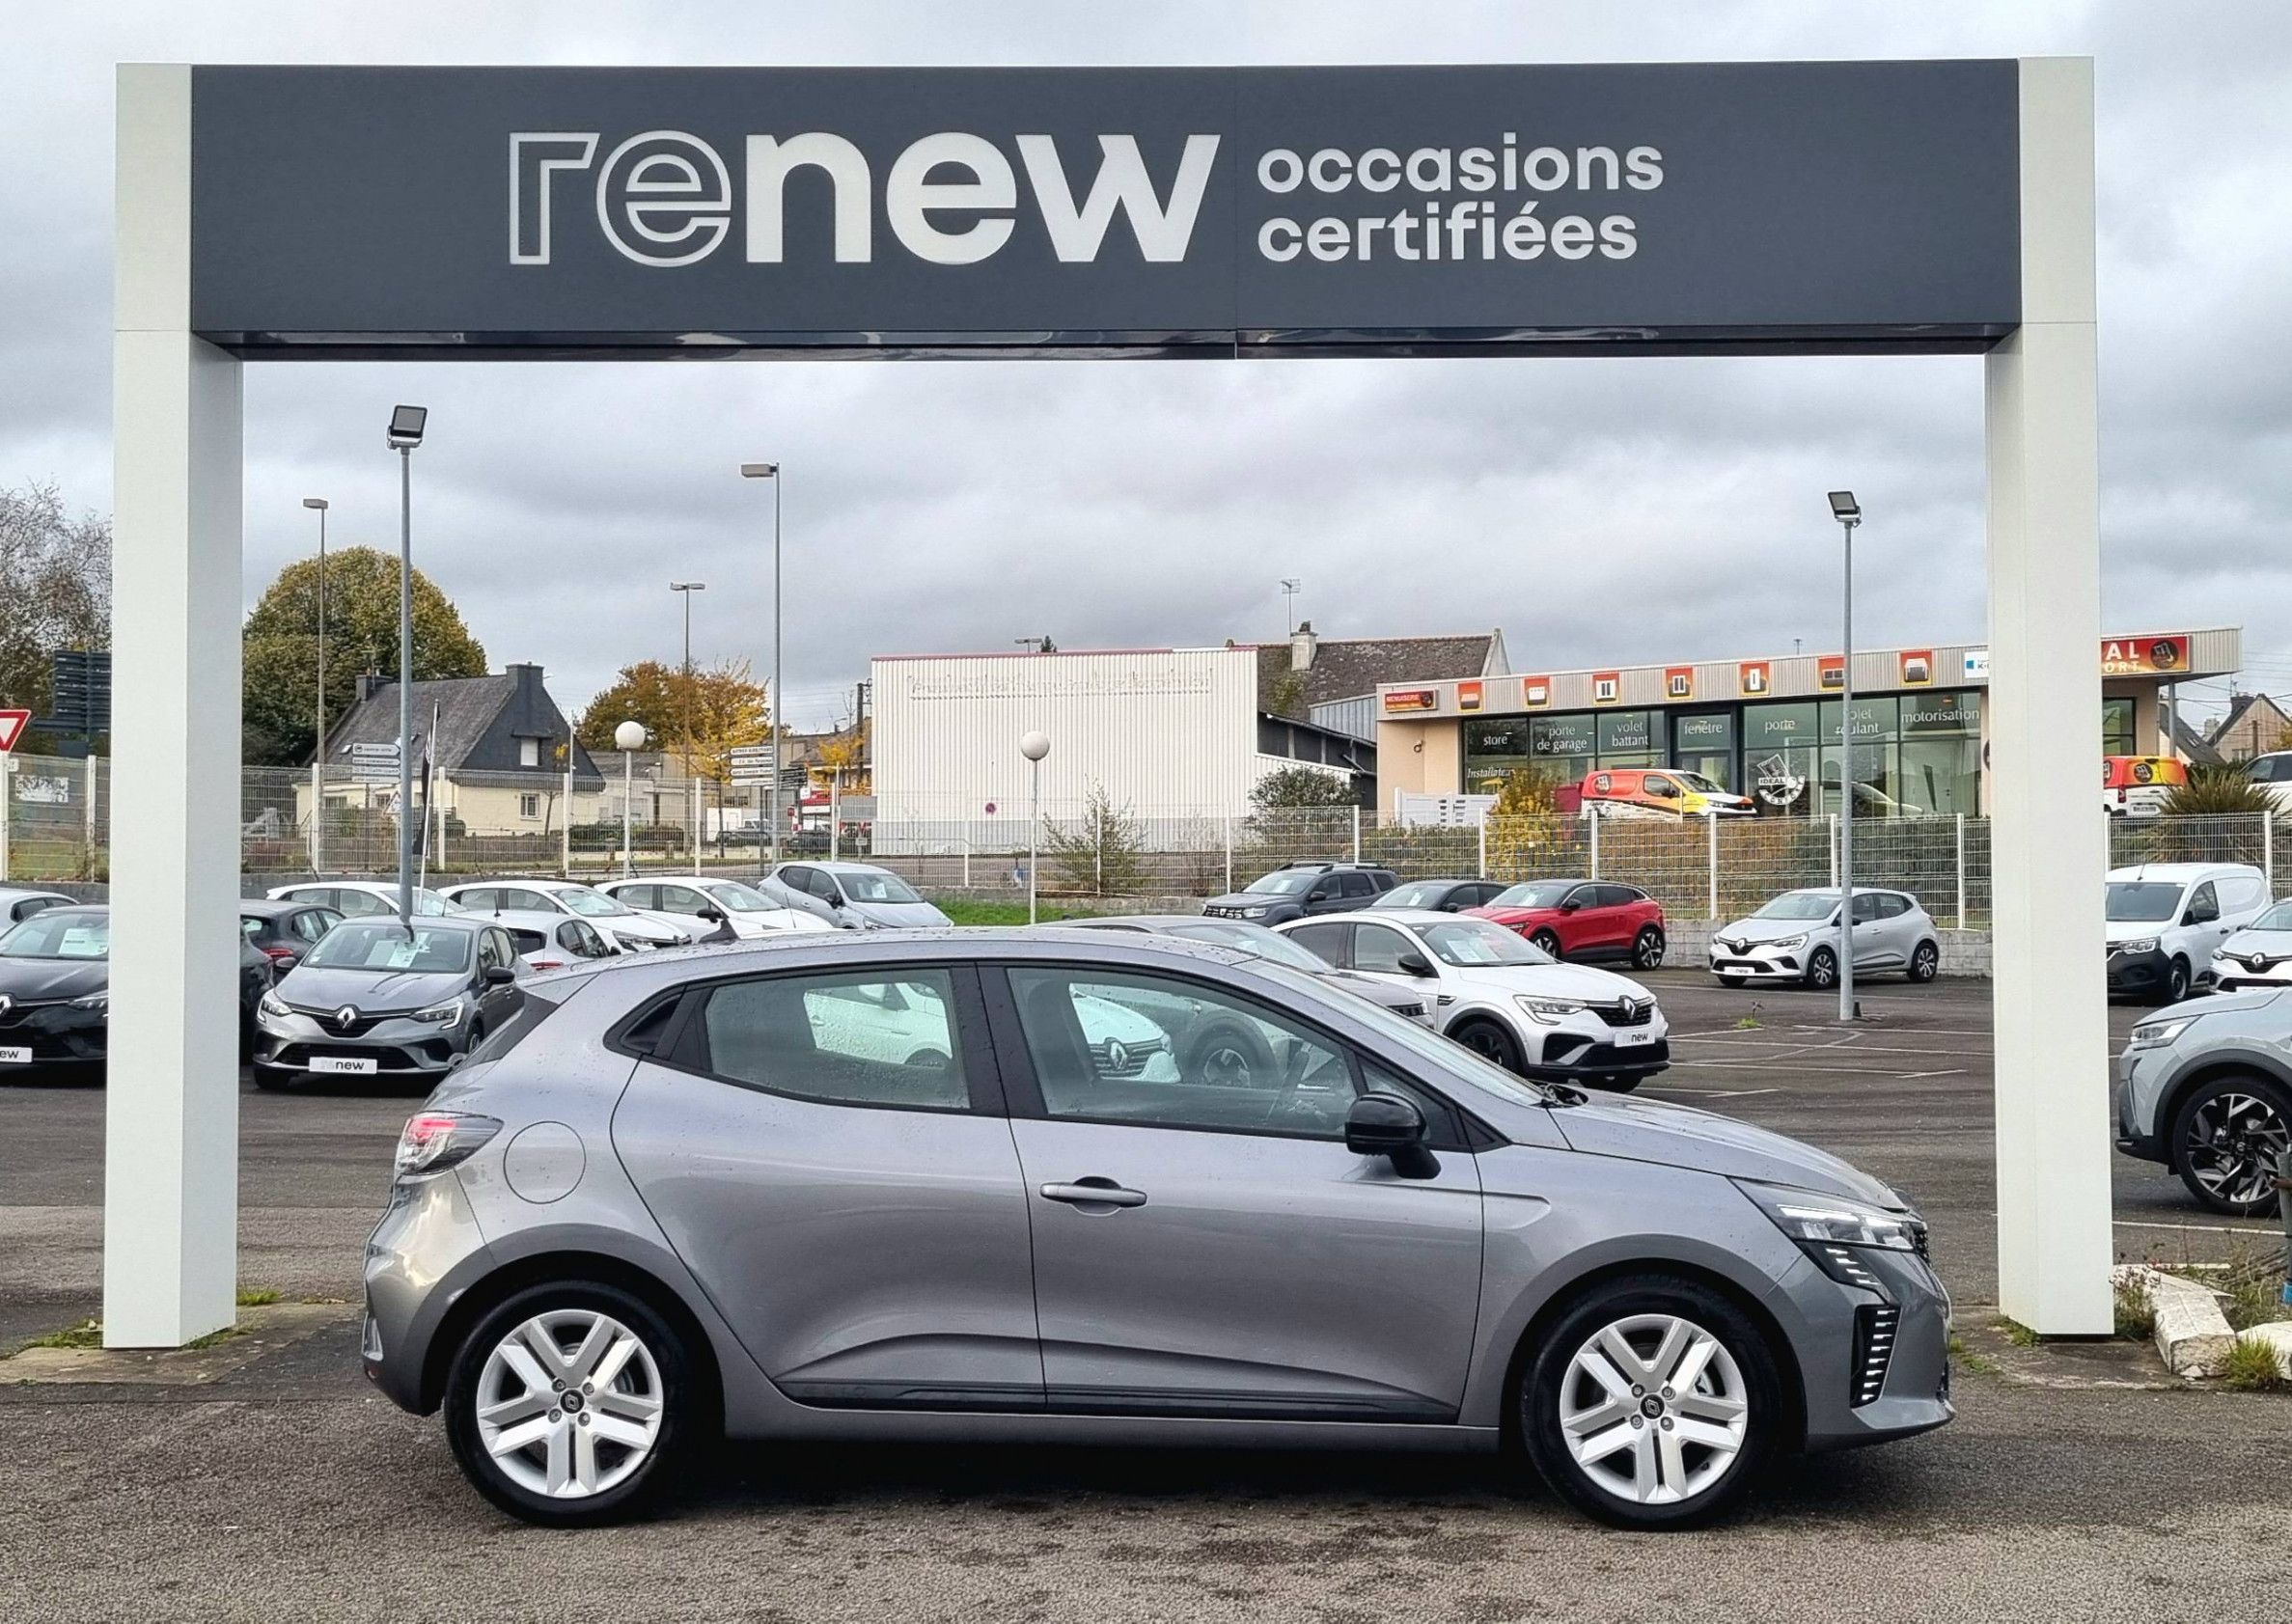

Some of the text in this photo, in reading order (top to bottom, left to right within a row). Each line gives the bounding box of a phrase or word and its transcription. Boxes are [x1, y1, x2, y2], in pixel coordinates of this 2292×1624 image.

[1256, 131, 1665, 193] occasions
[509, 129, 1222, 267] renew
[1257, 201, 1638, 262] certifiées
[1901, 707, 1980, 724] motorisation
[1548, 725, 1576, 739] porte
[1616, 720, 1644, 733] volet
[1764, 719, 1796, 734] porte
[1483, 734, 1508, 746] store
[1536, 737, 1588, 753] de garage
[1612, 734, 1649, 747] battant
